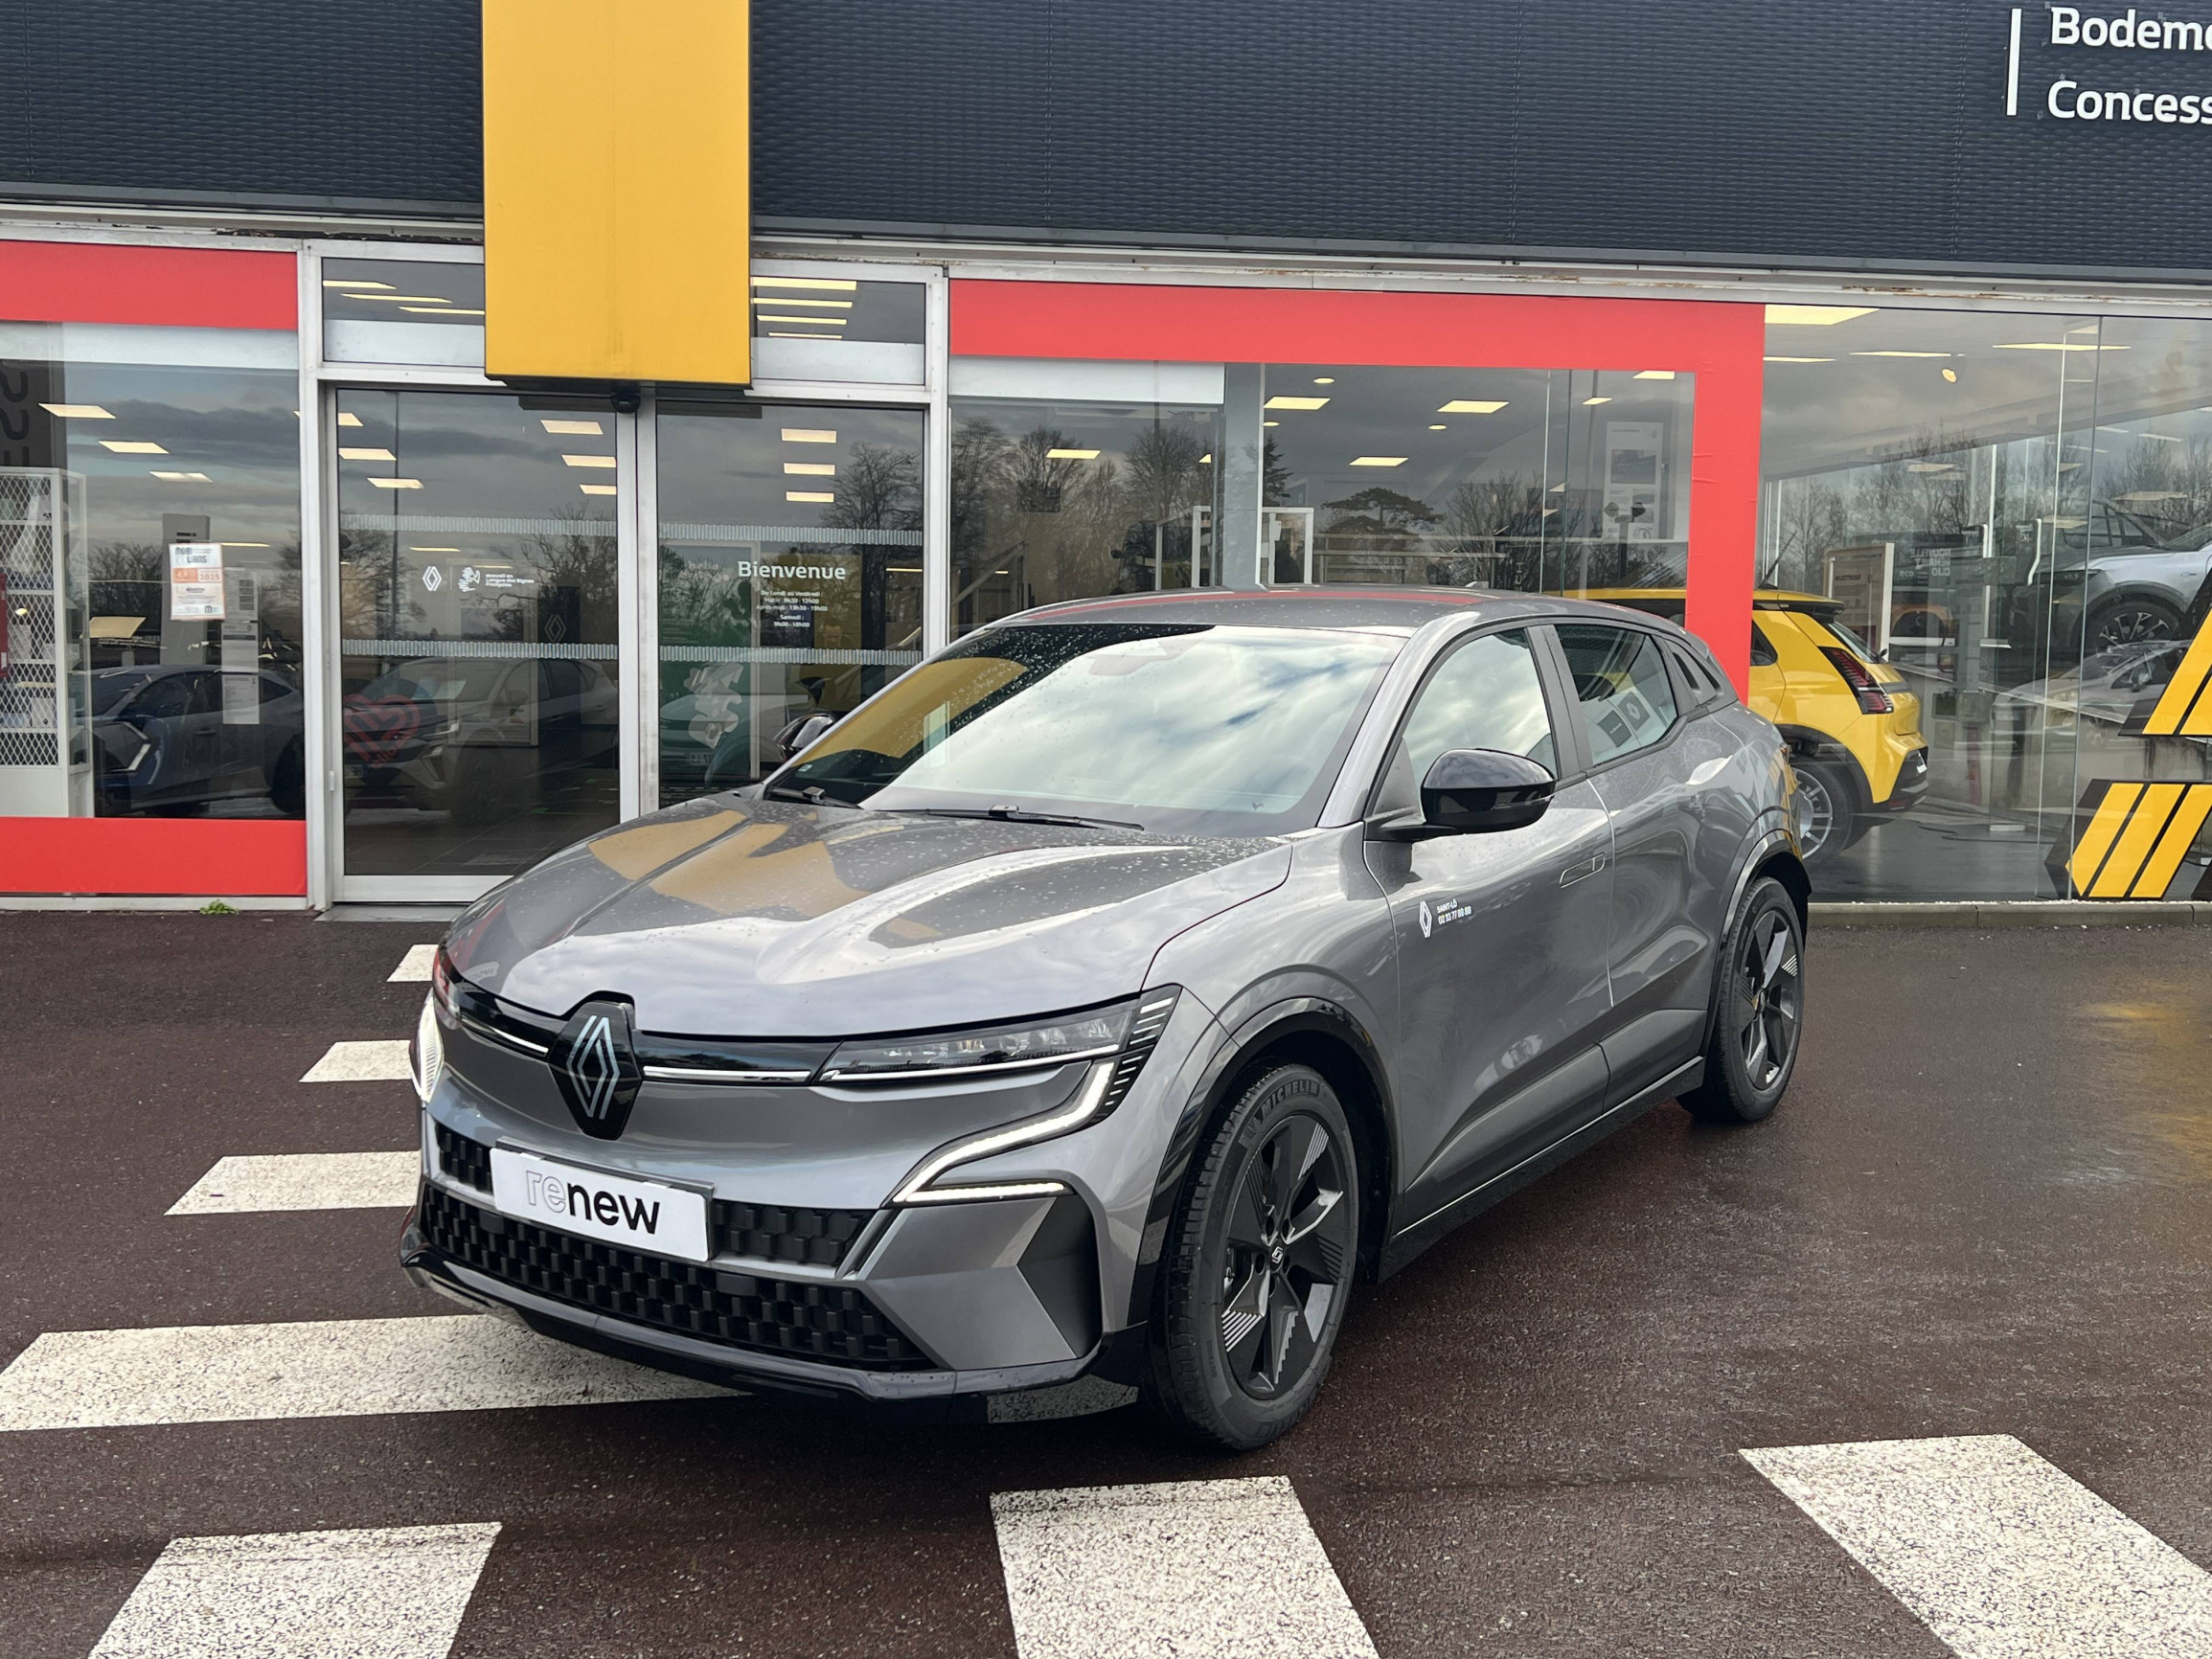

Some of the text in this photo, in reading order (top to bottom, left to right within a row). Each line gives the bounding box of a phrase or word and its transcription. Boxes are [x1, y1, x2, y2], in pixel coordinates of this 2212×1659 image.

[738, 560, 846, 580] Bienvenue
[1261, 1079, 1319, 1119] MICHELIN
[526, 1170, 661, 1235] renew
